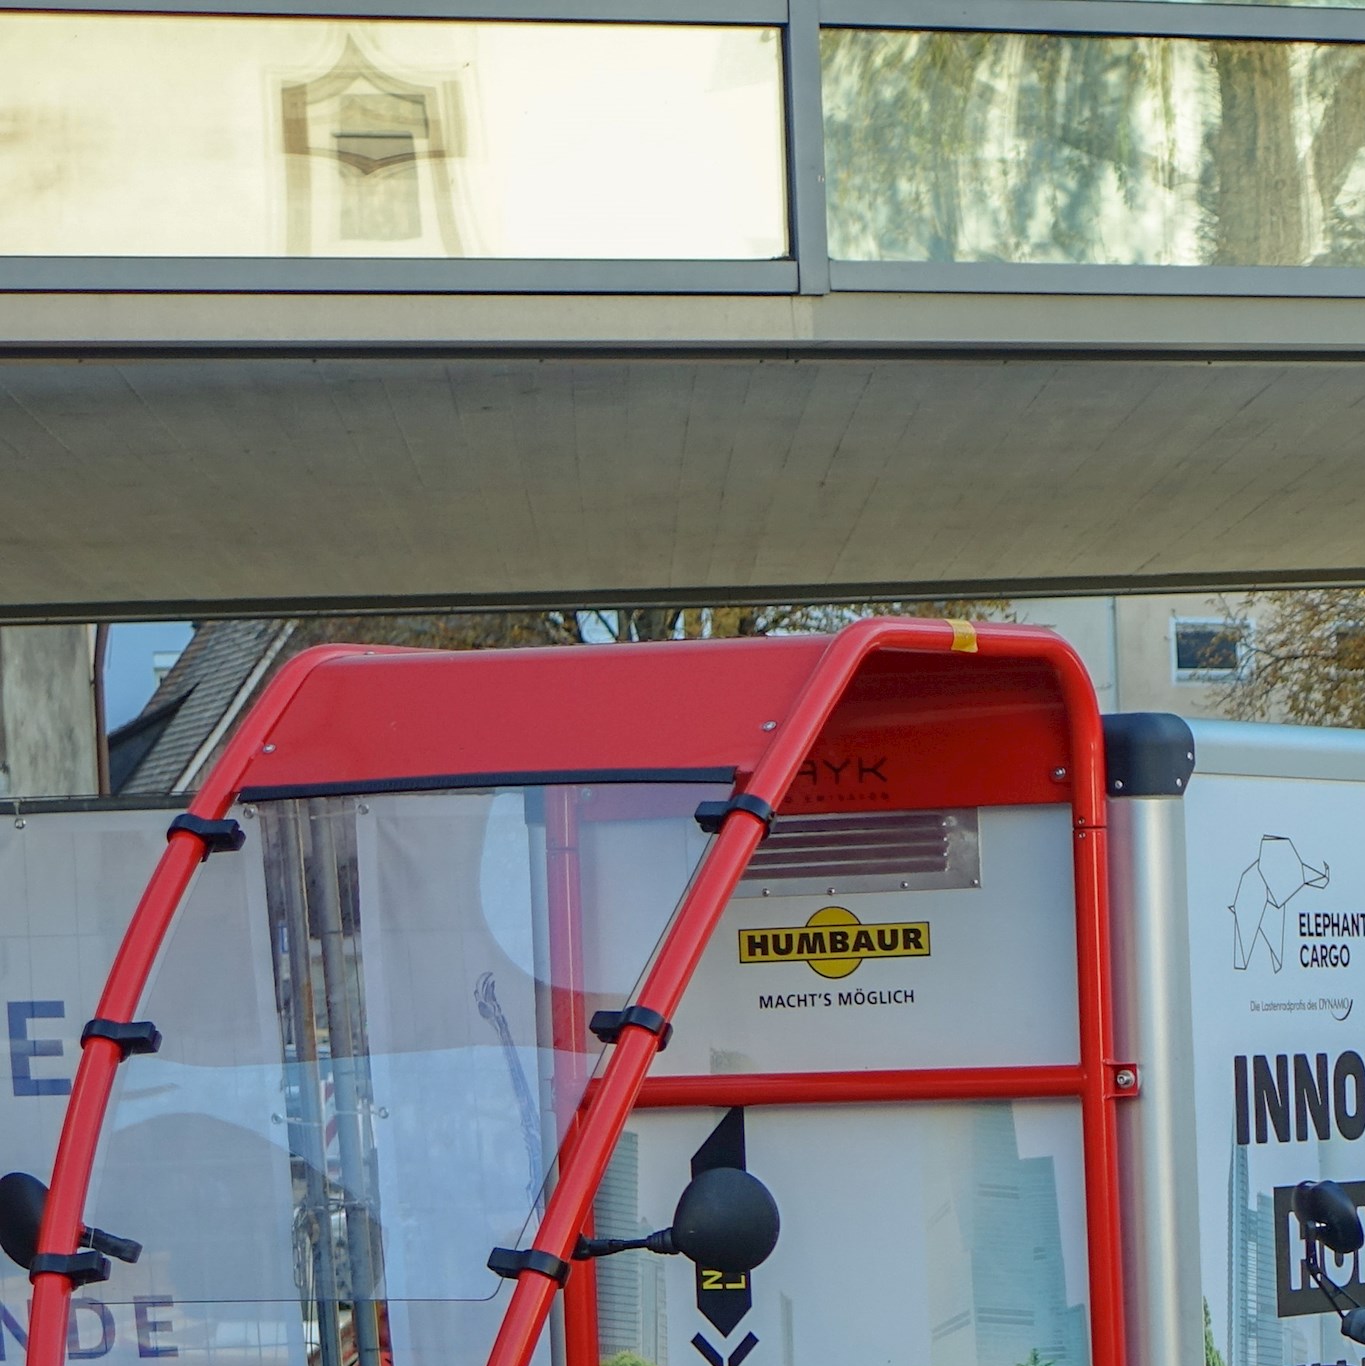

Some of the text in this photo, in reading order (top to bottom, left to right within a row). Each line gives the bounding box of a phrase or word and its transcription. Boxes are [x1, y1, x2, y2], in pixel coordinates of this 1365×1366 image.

[797, 757, 889, 785] AYK
[747, 928, 923, 957] HUMBAUR
[1299, 944, 1350, 968] CARGO
[759, 987, 914, 1009] MACHT'S MÖGLICH
[1250, 1000, 1260, 1012] Die
[1318, 997, 1350, 1010] DYNAMO
